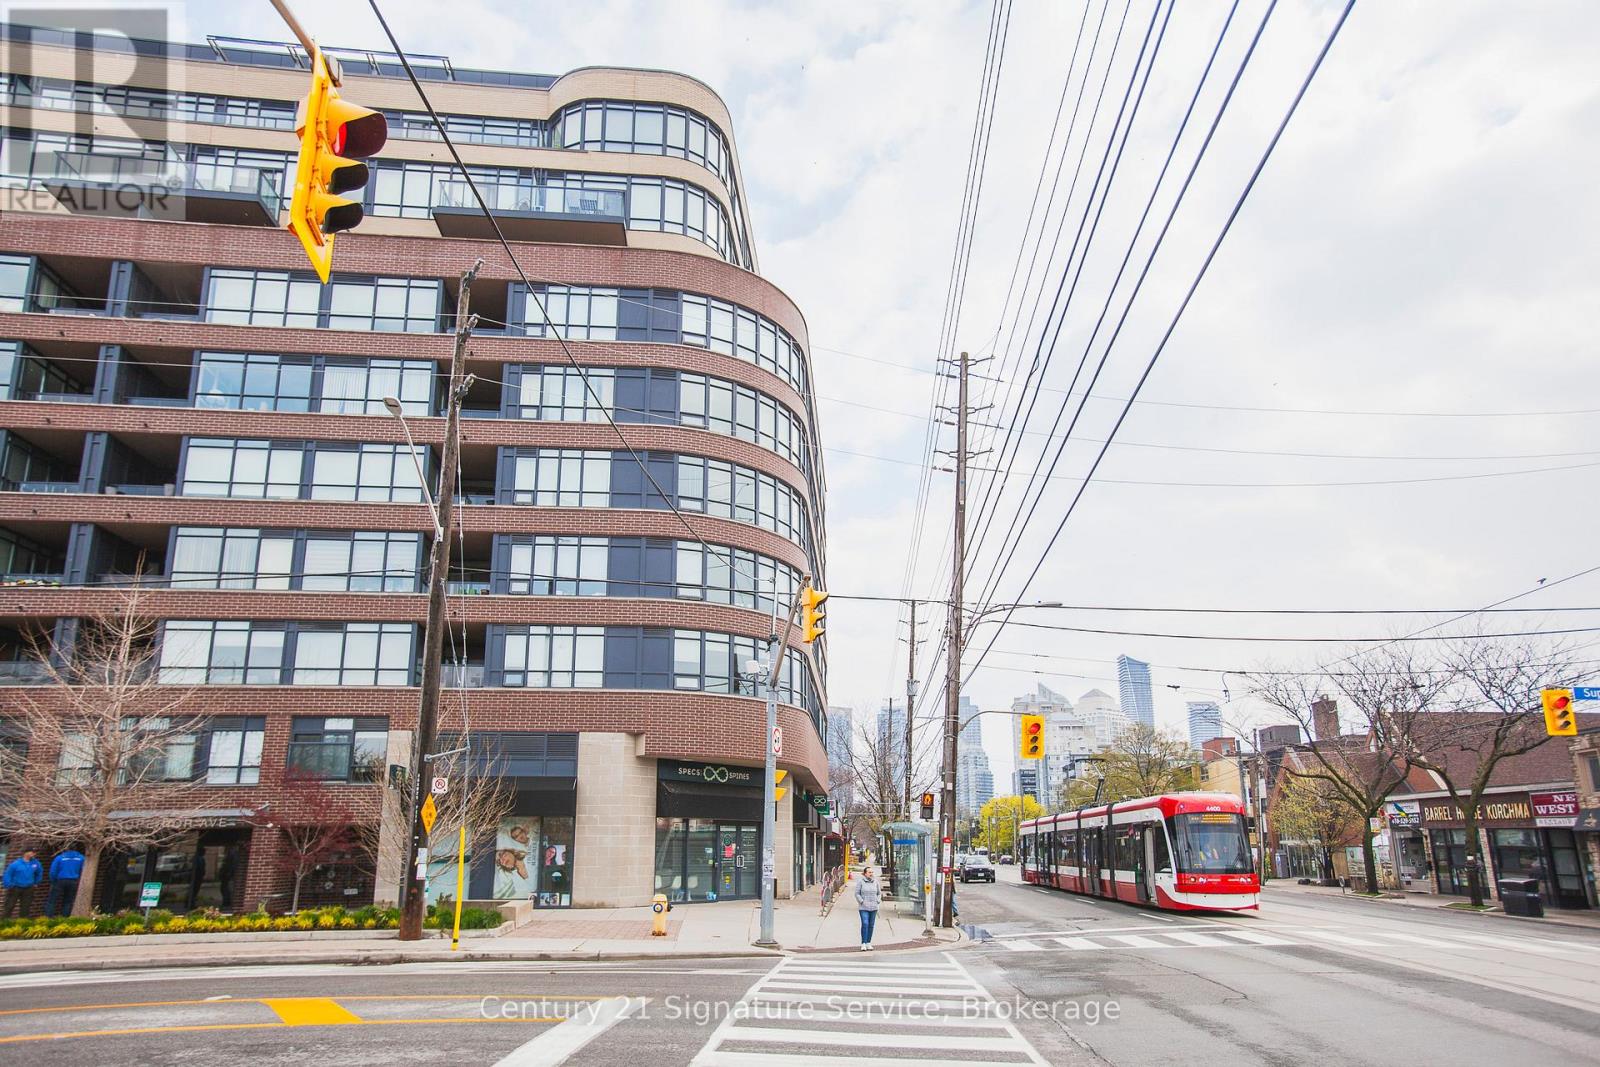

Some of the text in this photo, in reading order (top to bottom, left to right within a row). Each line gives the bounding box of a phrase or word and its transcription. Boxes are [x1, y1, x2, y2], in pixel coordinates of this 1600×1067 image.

[678, 767, 750, 780] SPECS SPINES
[1424, 806, 1453, 821] BARREL
[1486, 803, 1531, 820] KORCHMA
[199, 818, 227, 828] AVE
